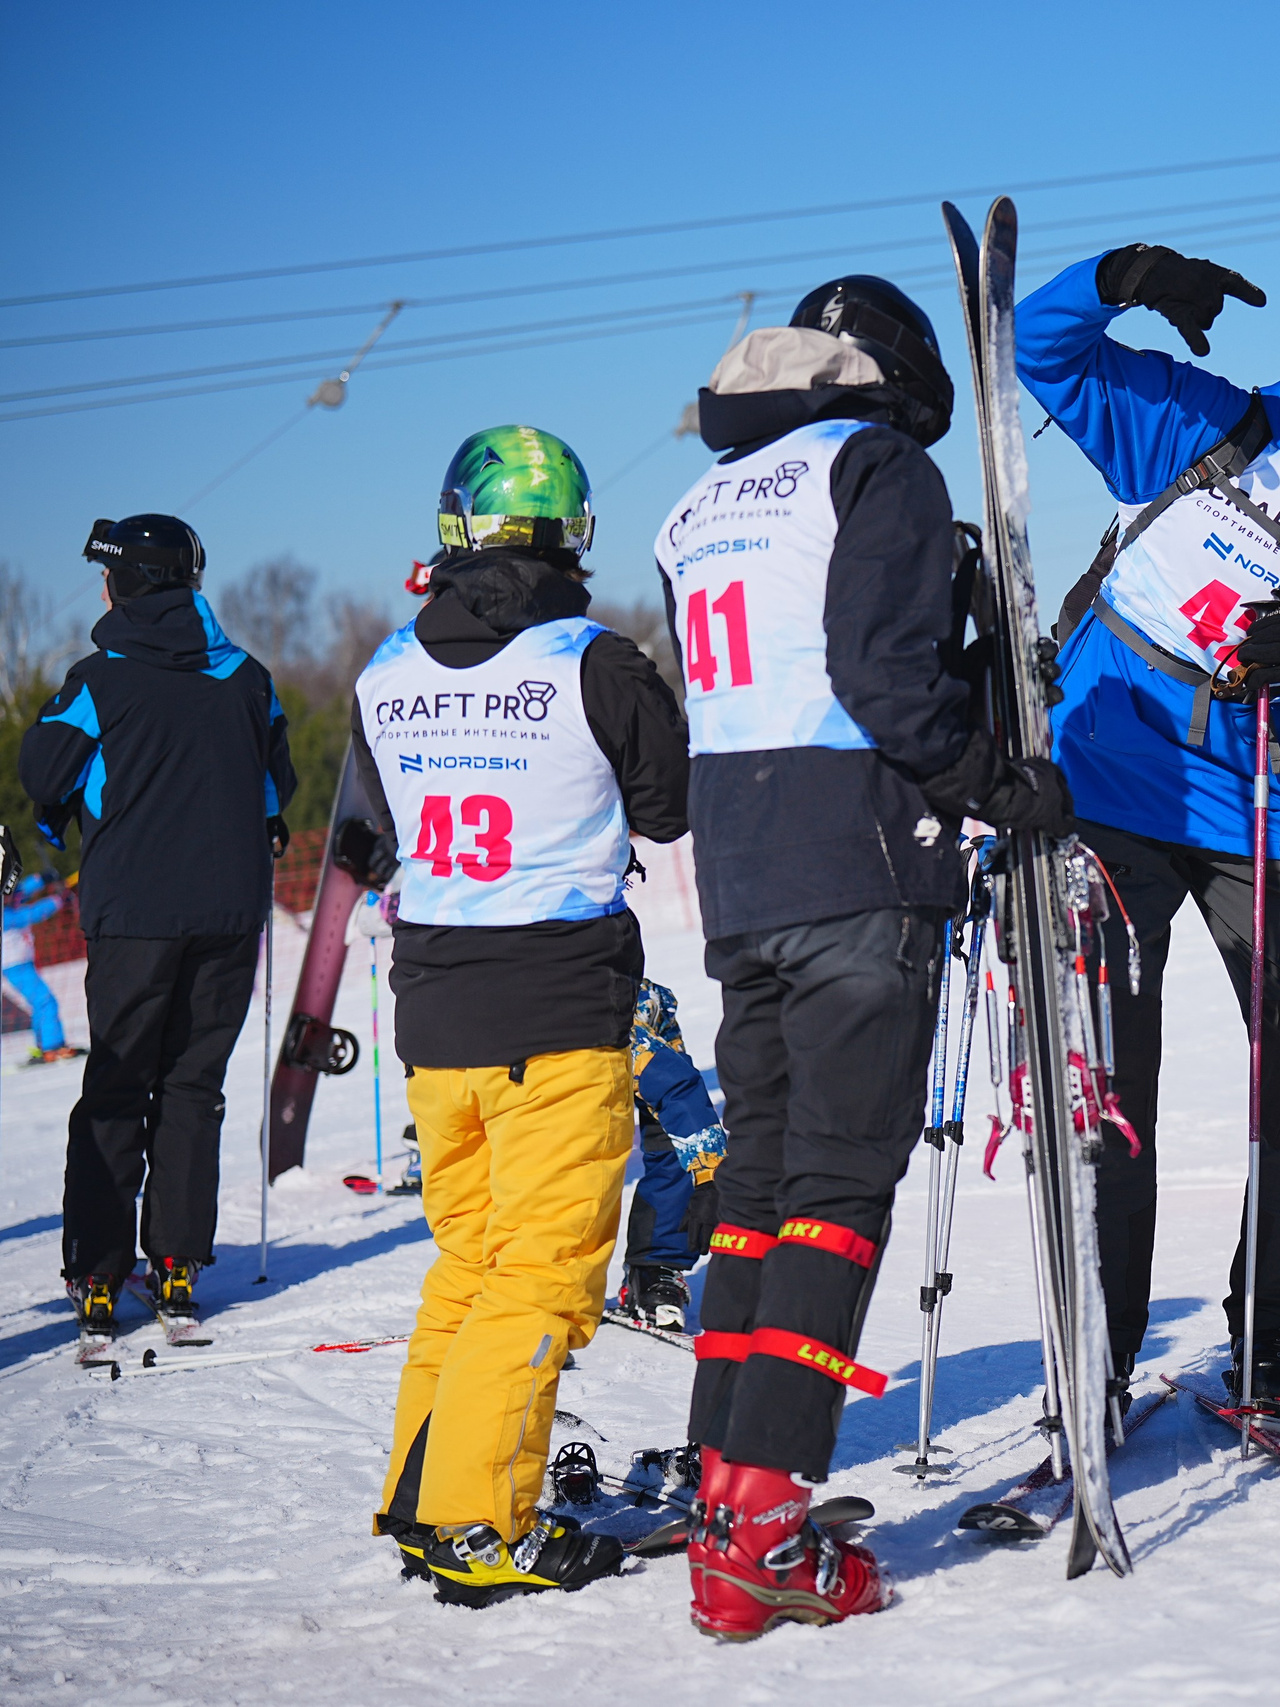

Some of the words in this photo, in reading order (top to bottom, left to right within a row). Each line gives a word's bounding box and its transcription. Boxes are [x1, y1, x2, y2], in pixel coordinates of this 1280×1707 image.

[1196, 499, 1280, 555] СПОРТИВНЫЕ
[90, 540, 123, 556] SMITH
[683, 537, 770, 564] NORDSKI
[687, 580, 753, 692] 41
[376, 694, 475, 725] CRAFT
[485, 693, 548, 721] PRO
[464, 728, 550, 741] ИНТЕНСИВЫ
[428, 756, 527, 771] NORDSKI
[410, 794, 513, 882] 43
[797, 1343, 856, 1379] LEKI
[976, 1516, 1019, 1530] K2
[583, 1535, 601, 1565] SCARP
